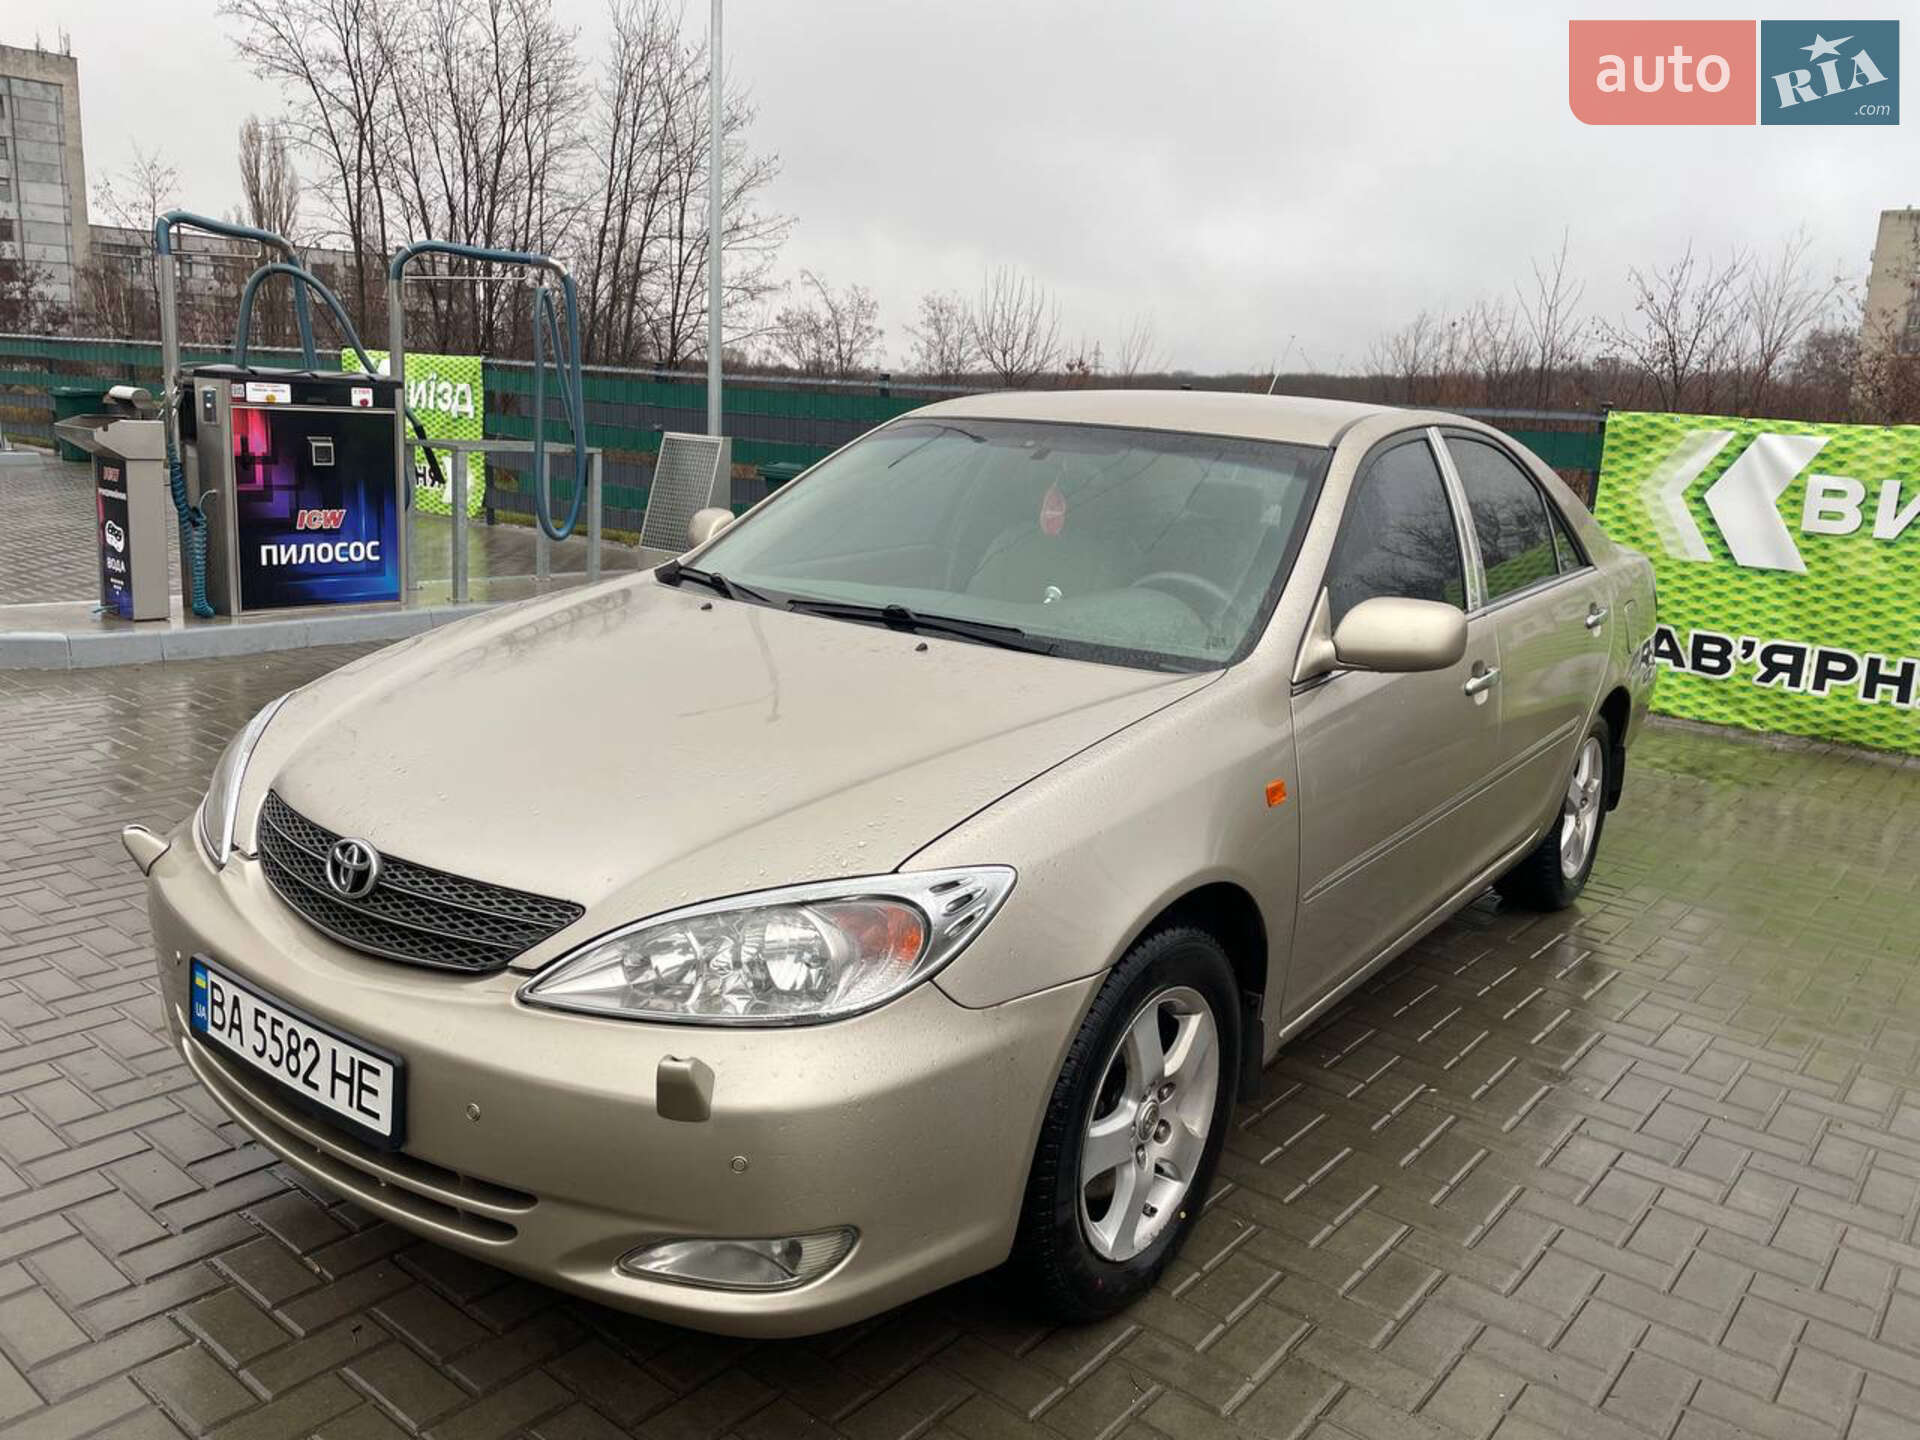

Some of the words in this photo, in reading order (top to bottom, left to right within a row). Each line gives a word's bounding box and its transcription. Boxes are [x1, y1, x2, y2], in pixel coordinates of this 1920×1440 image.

[405, 372, 475, 420] ИЇЗД
[296, 509, 346, 530] ICW
[260, 541, 380, 566] ПИЛОСОС
[194, 1002, 208, 1020] UA
[210, 979, 244, 1047] BA
[252, 1007, 321, 1092] 5582
[330, 1048, 381, 1121] HE
